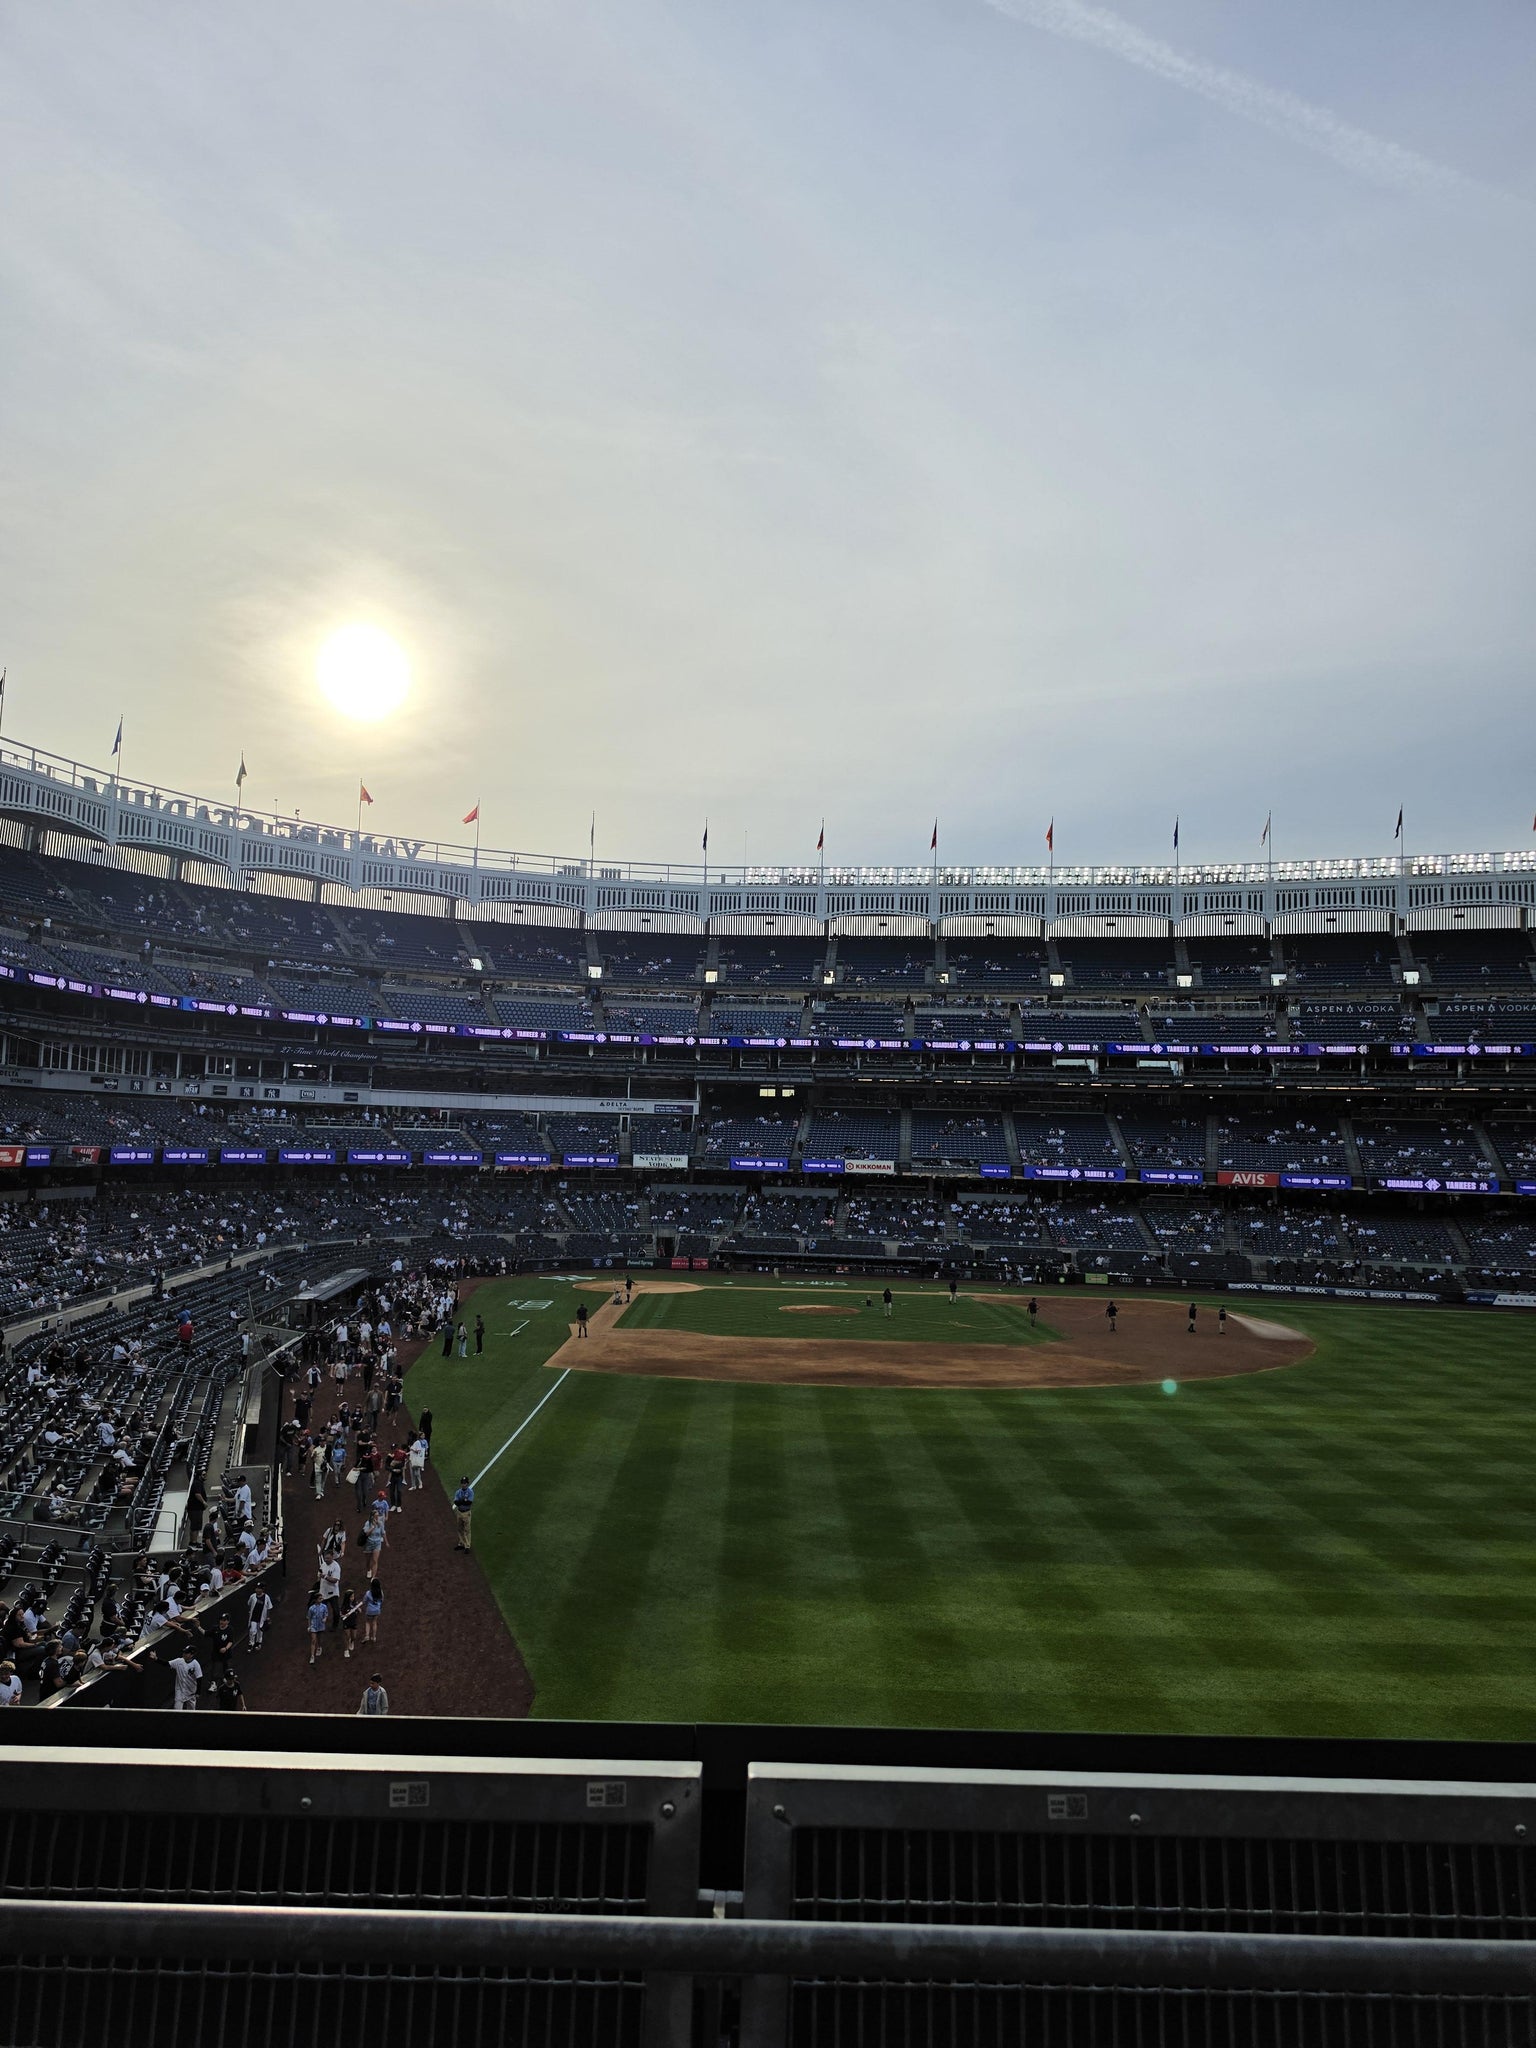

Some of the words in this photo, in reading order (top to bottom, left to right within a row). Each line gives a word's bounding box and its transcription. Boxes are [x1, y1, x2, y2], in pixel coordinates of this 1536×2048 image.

[1306, 1005, 1343, 1013] ASPEN
[1357, 1005, 1395, 1013] VODKA
[1445, 1004, 1484, 1013] ASPEN
[1232, 1174, 1265, 1185] AVIS
